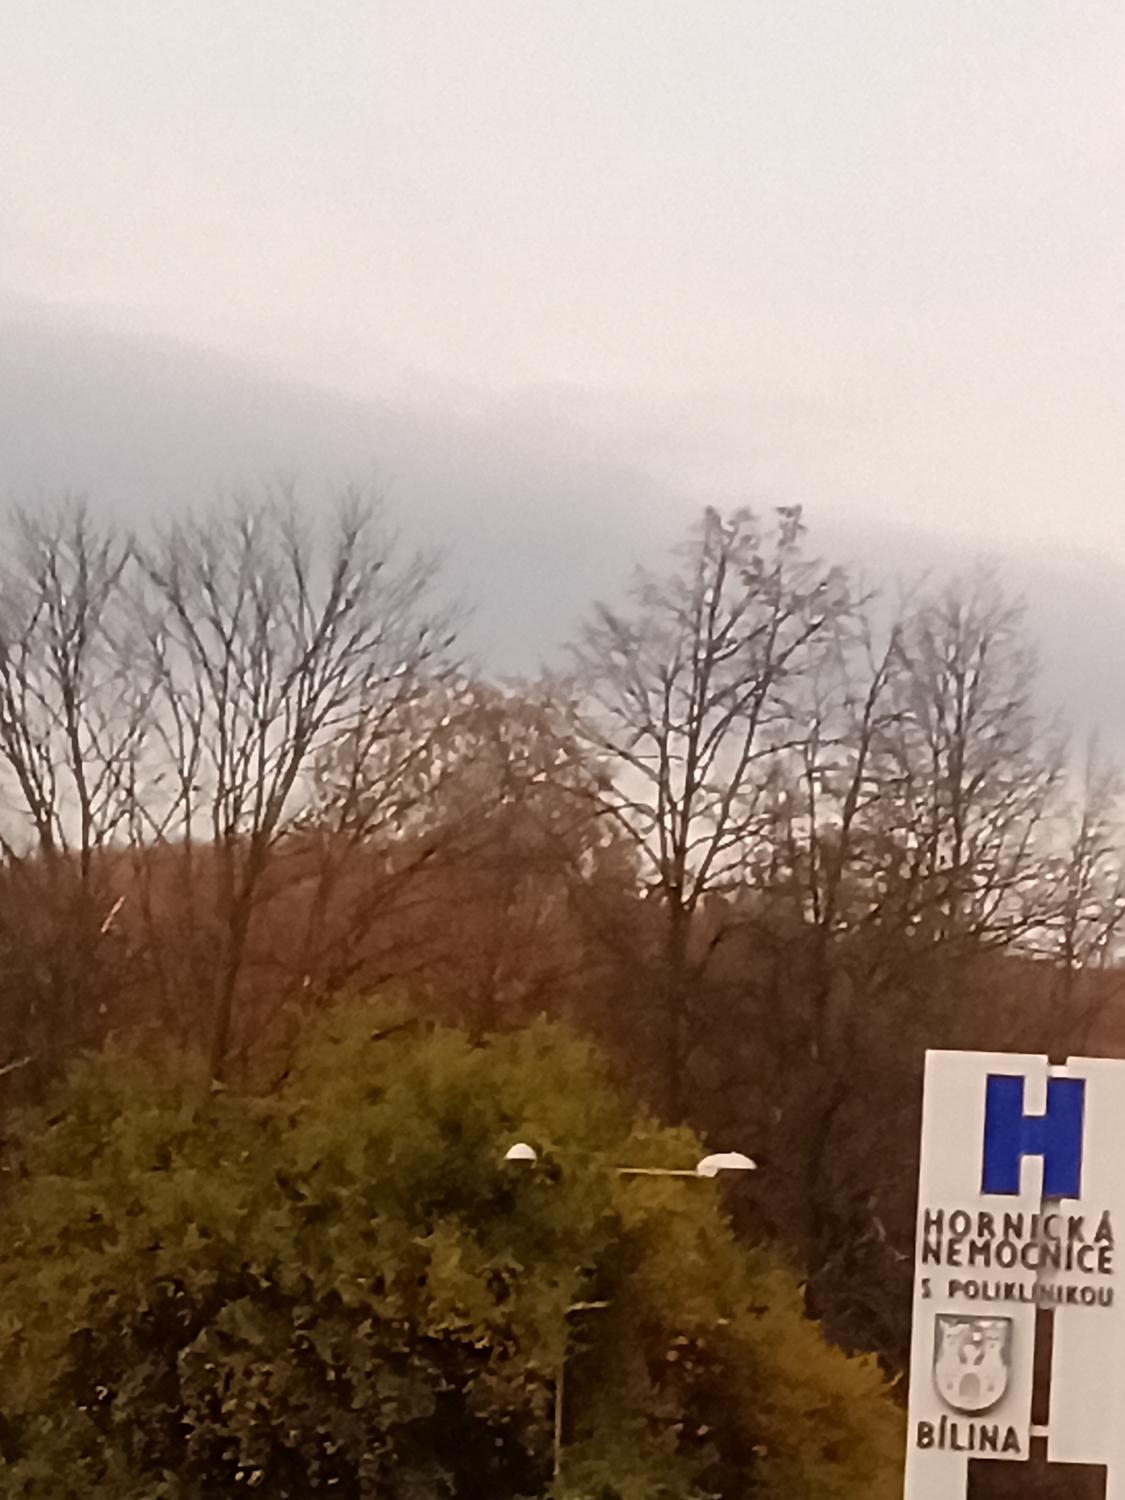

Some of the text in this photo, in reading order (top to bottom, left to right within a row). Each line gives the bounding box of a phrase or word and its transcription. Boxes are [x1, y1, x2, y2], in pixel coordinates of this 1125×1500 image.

[981, 1073, 1085, 1199] H
[924, 1208, 1114, 1243] HORNICKÁ
[922, 1237, 1114, 1275] NEMOCNICE
[921, 1277, 1114, 1307] S POLIKLINIKOU
[917, 1415, 1021, 1453] BÍLINA
